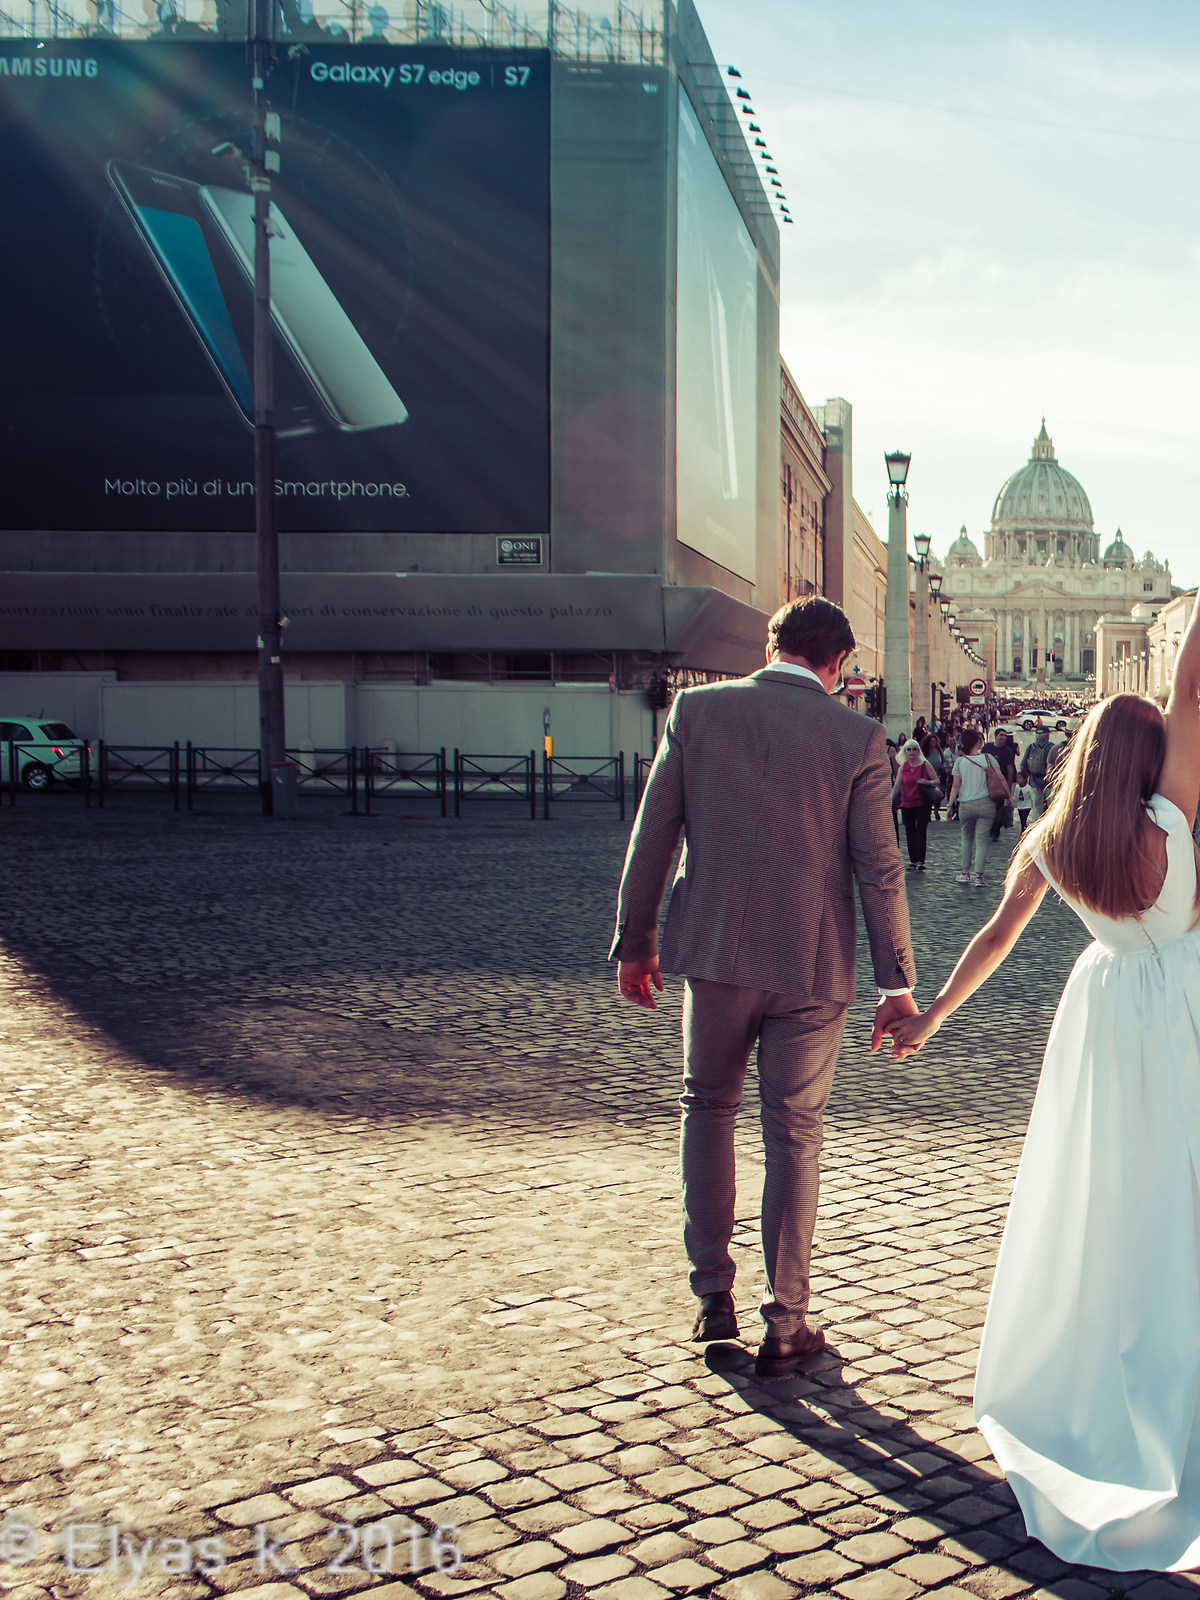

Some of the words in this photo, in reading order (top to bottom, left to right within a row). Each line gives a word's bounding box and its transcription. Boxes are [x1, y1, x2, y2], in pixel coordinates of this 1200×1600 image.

[310, 62, 395, 88] Galaxy
[399, 64, 425, 84] S7
[428, 68, 480, 90] edge
[504, 66, 531, 86] S7
[104, 478, 161, 496] Molto
[165, 478, 198, 500] più
[203, 479, 222, 496] di
[274, 479, 411, 500] Smartphone.
[513, 541, 537, 550] ONE
[106, 606, 144, 616] sono
[150, 603, 237, 617] finalizzate
[243, 603, 258, 617] ai
[319, 603, 336, 617] di
[342, 604, 461, 617] conservazione
[467, 604, 484, 617] di
[489, 606, 544, 620] questo
[550, 604, 613, 620] palazzo
